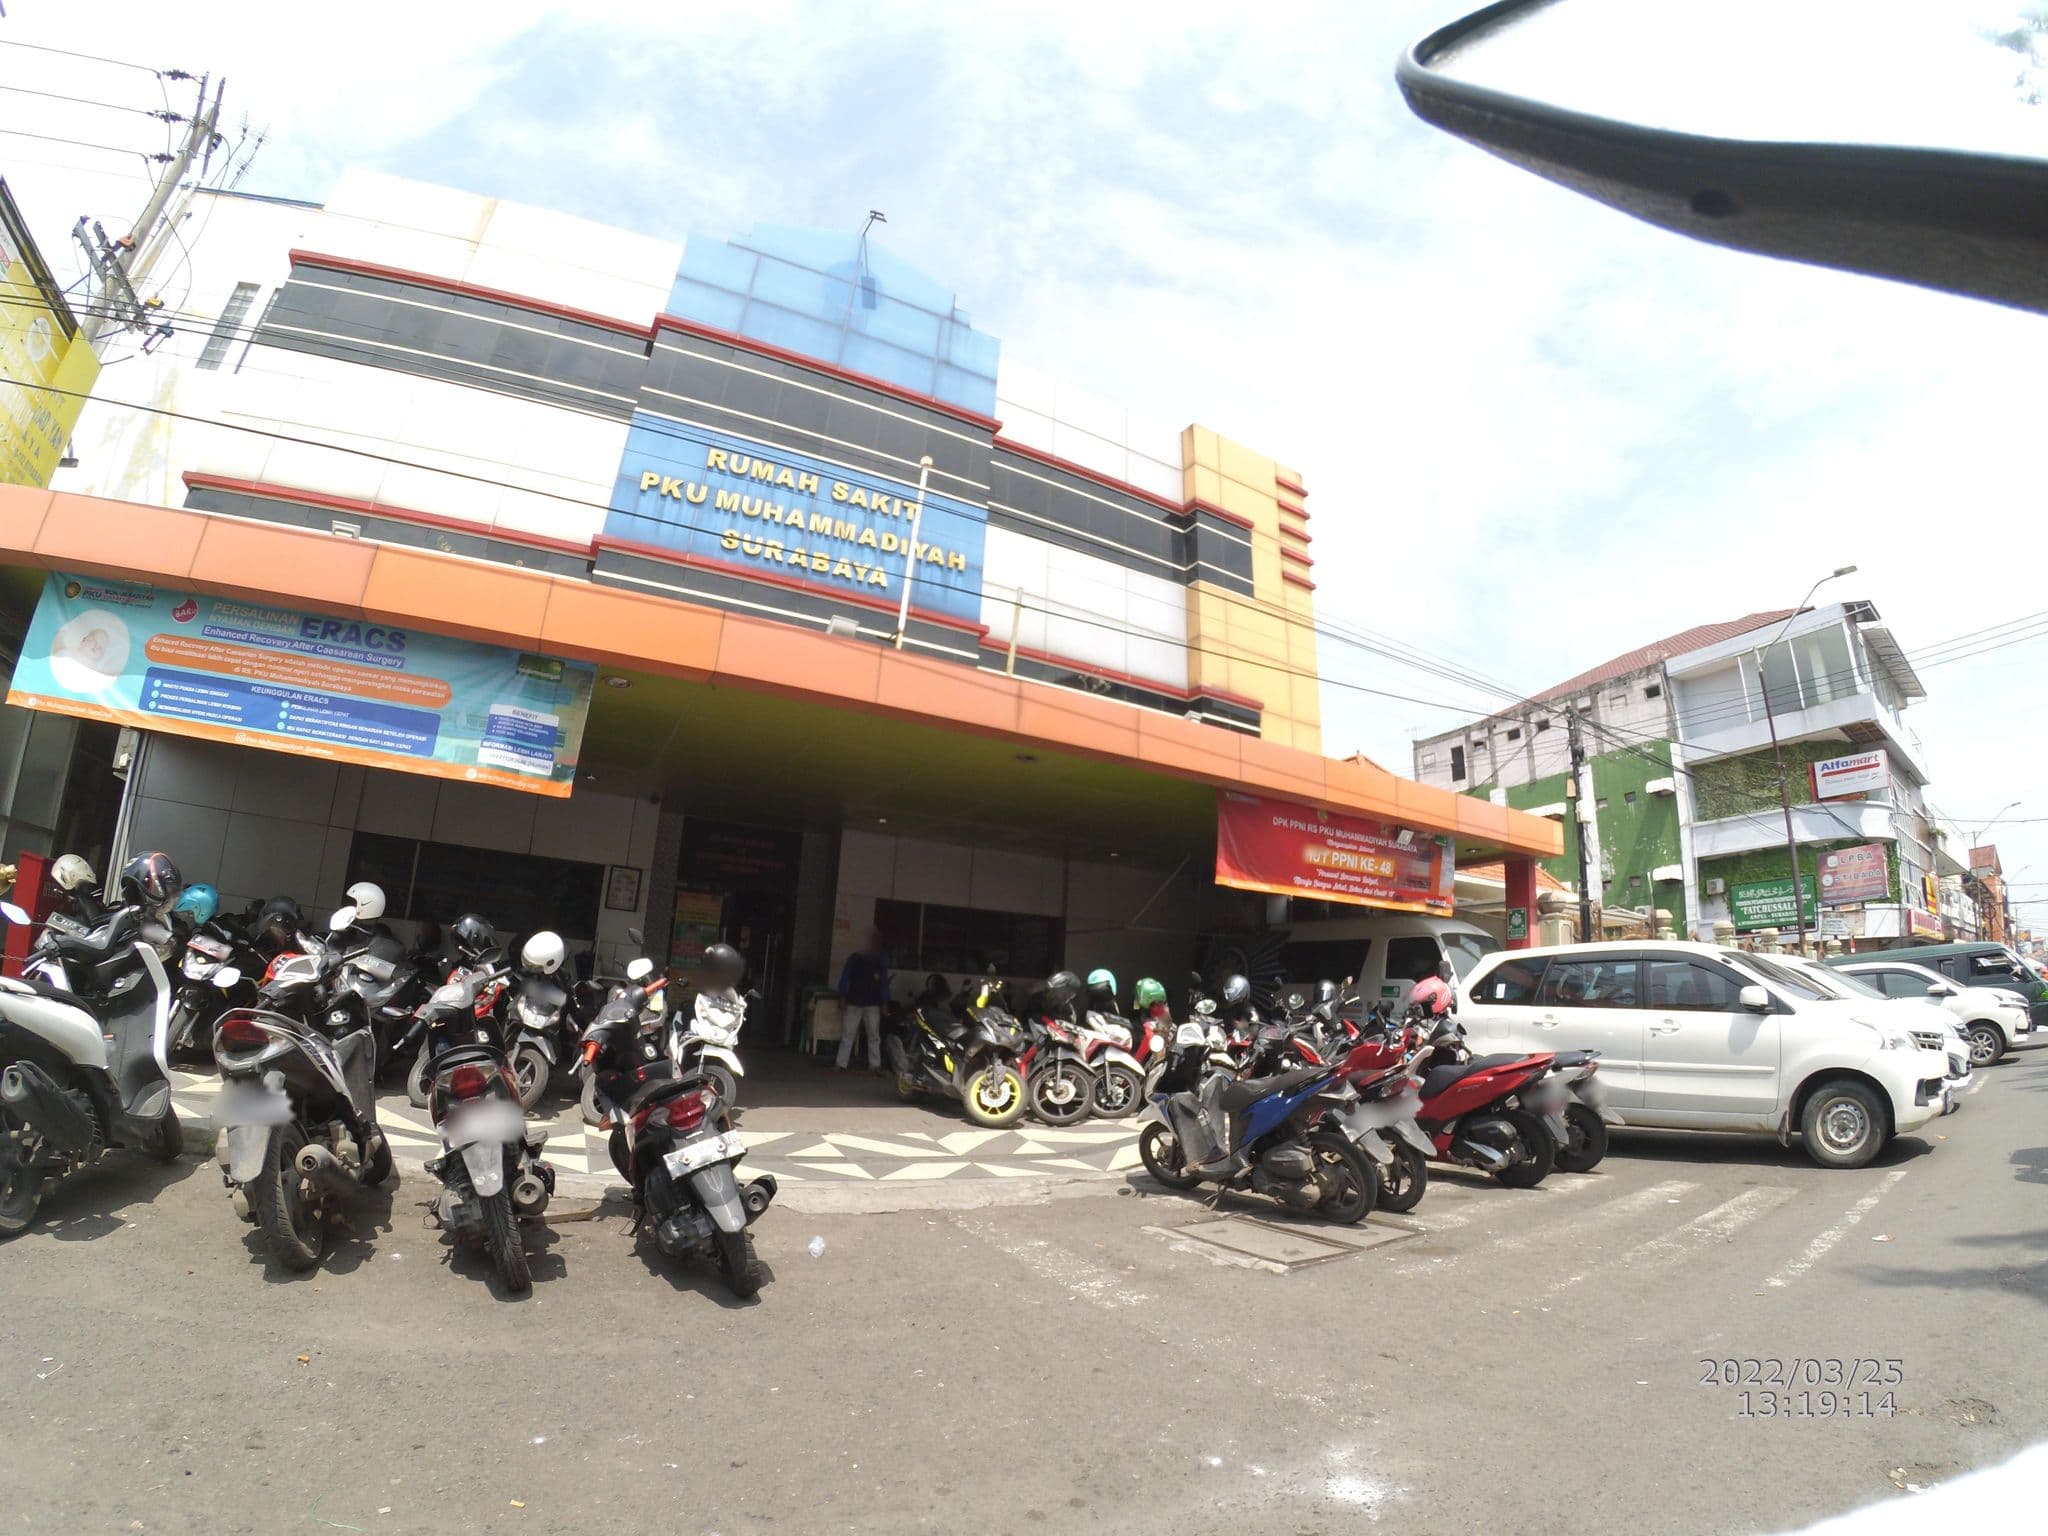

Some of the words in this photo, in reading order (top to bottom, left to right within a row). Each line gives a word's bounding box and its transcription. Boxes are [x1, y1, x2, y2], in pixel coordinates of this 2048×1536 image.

[707, 447, 818, 494] RUMAH
[832, 481, 918, 521] SAKIT
[640, 471, 707, 504] PKU
[715, 489, 966, 571] MUHAMMADIYAH
[720, 529, 888, 588] SURABAYA
[175, 607, 197, 619] BARU
[211, 602, 298, 625] PERSALINAN
[300, 616, 408, 652] ERACS
[203, 625, 248, 640] Enhanced
[249, 632, 292, 649] Recovery
[291, 640, 314, 652] After
[316, 643, 364, 660] Caesarean
[366, 652, 403, 667] Surgery
[251, 684, 302, 699] KEUNGGULAN
[303, 694, 329, 705] ERACS
[1820, 753, 1879, 772] Alfamart
[1289, 819, 1306, 831] PPNI
[1319, 824, 1335, 837] PKU
[1331, 852, 1358, 868] PPNI
